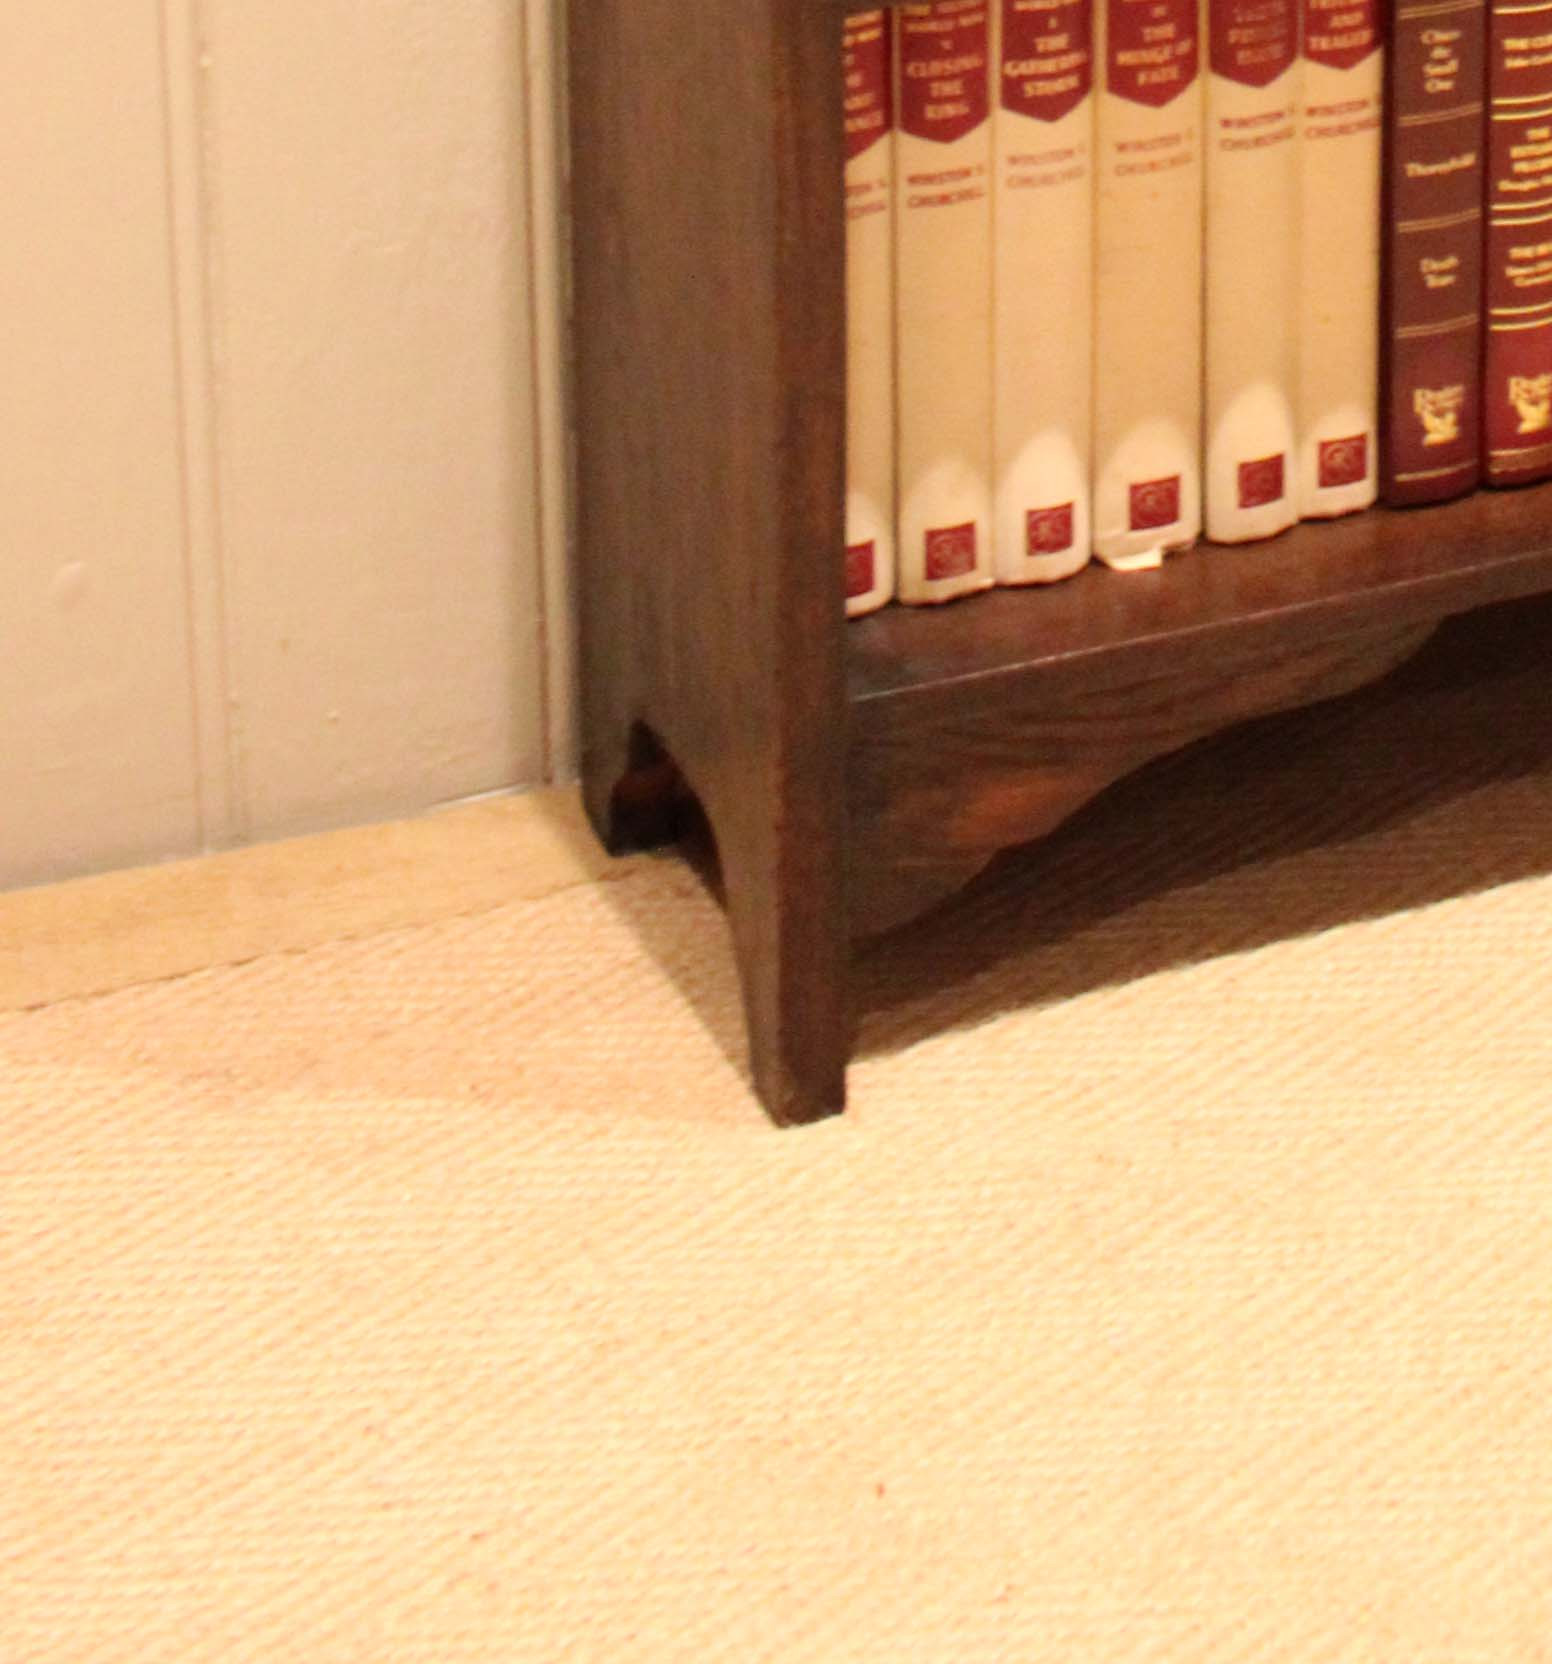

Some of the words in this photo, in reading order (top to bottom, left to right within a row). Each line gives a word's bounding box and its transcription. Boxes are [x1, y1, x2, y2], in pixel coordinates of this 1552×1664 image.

[1329, 10, 1365, 30] AND
[1035, 33, 1070, 54] THE
[1142, 23, 1175, 43] THE
[1308, 29, 1374, 53] TRAGEDY
[1116, 43, 1172, 66] HINGE
[1174, 37, 1192, 56] OF
[906, 53, 984, 79] CLOSING
[1003, 51, 1088, 78] GATHERING
[1137, 64, 1180, 87] FATE
[930, 79, 965, 99] THE
[1023, 74, 1080, 99] STORM
[925, 102, 971, 121] RING
